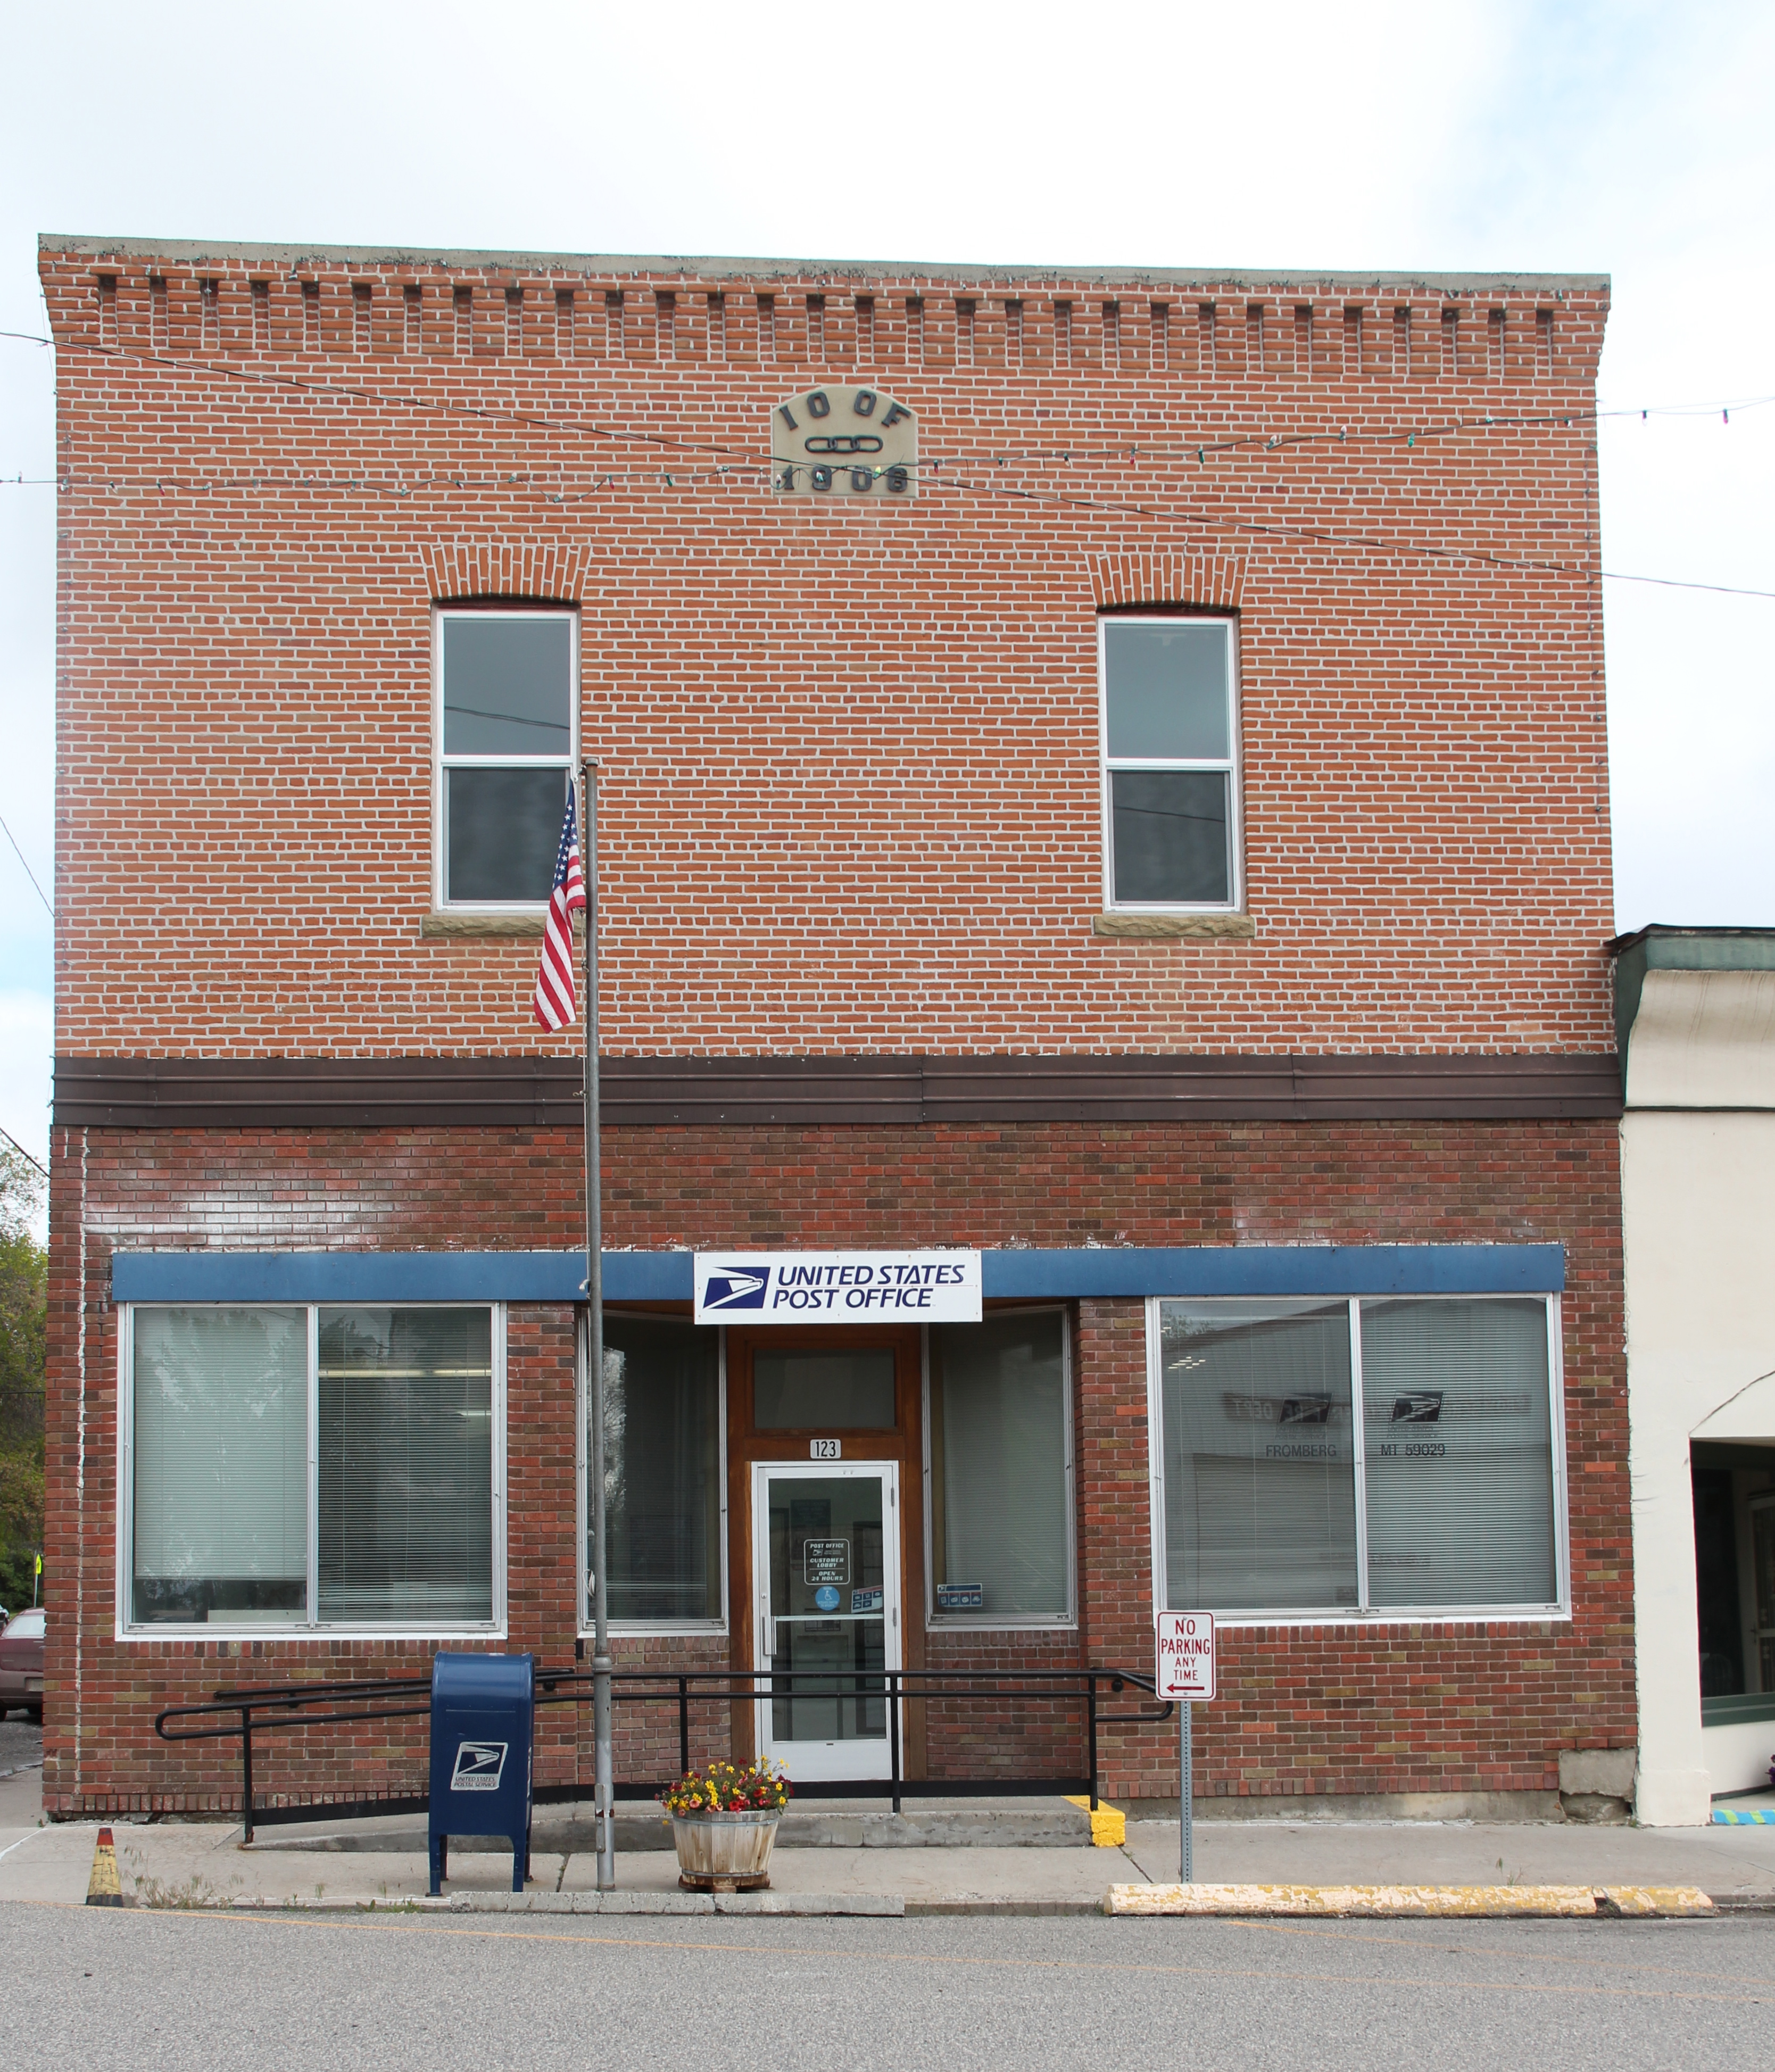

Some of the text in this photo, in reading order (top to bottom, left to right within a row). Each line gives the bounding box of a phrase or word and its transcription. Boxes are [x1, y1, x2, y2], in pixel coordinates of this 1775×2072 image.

[778, 1265, 965, 1286] UNITED STATES
[773, 1288, 933, 1309] POST OFFICE
[815, 1440, 836, 1457] 123
[1266, 1445, 1337, 1457] FROMBERG
[1381, 1443, 1445, 1456] MT 59029
[1176, 1619, 1196, 1635] NO
[1161, 1638, 1210, 1655] PARKING
[1175, 1657, 1196, 1667] ANY
[1174, 1670, 1198, 1680] TIME
